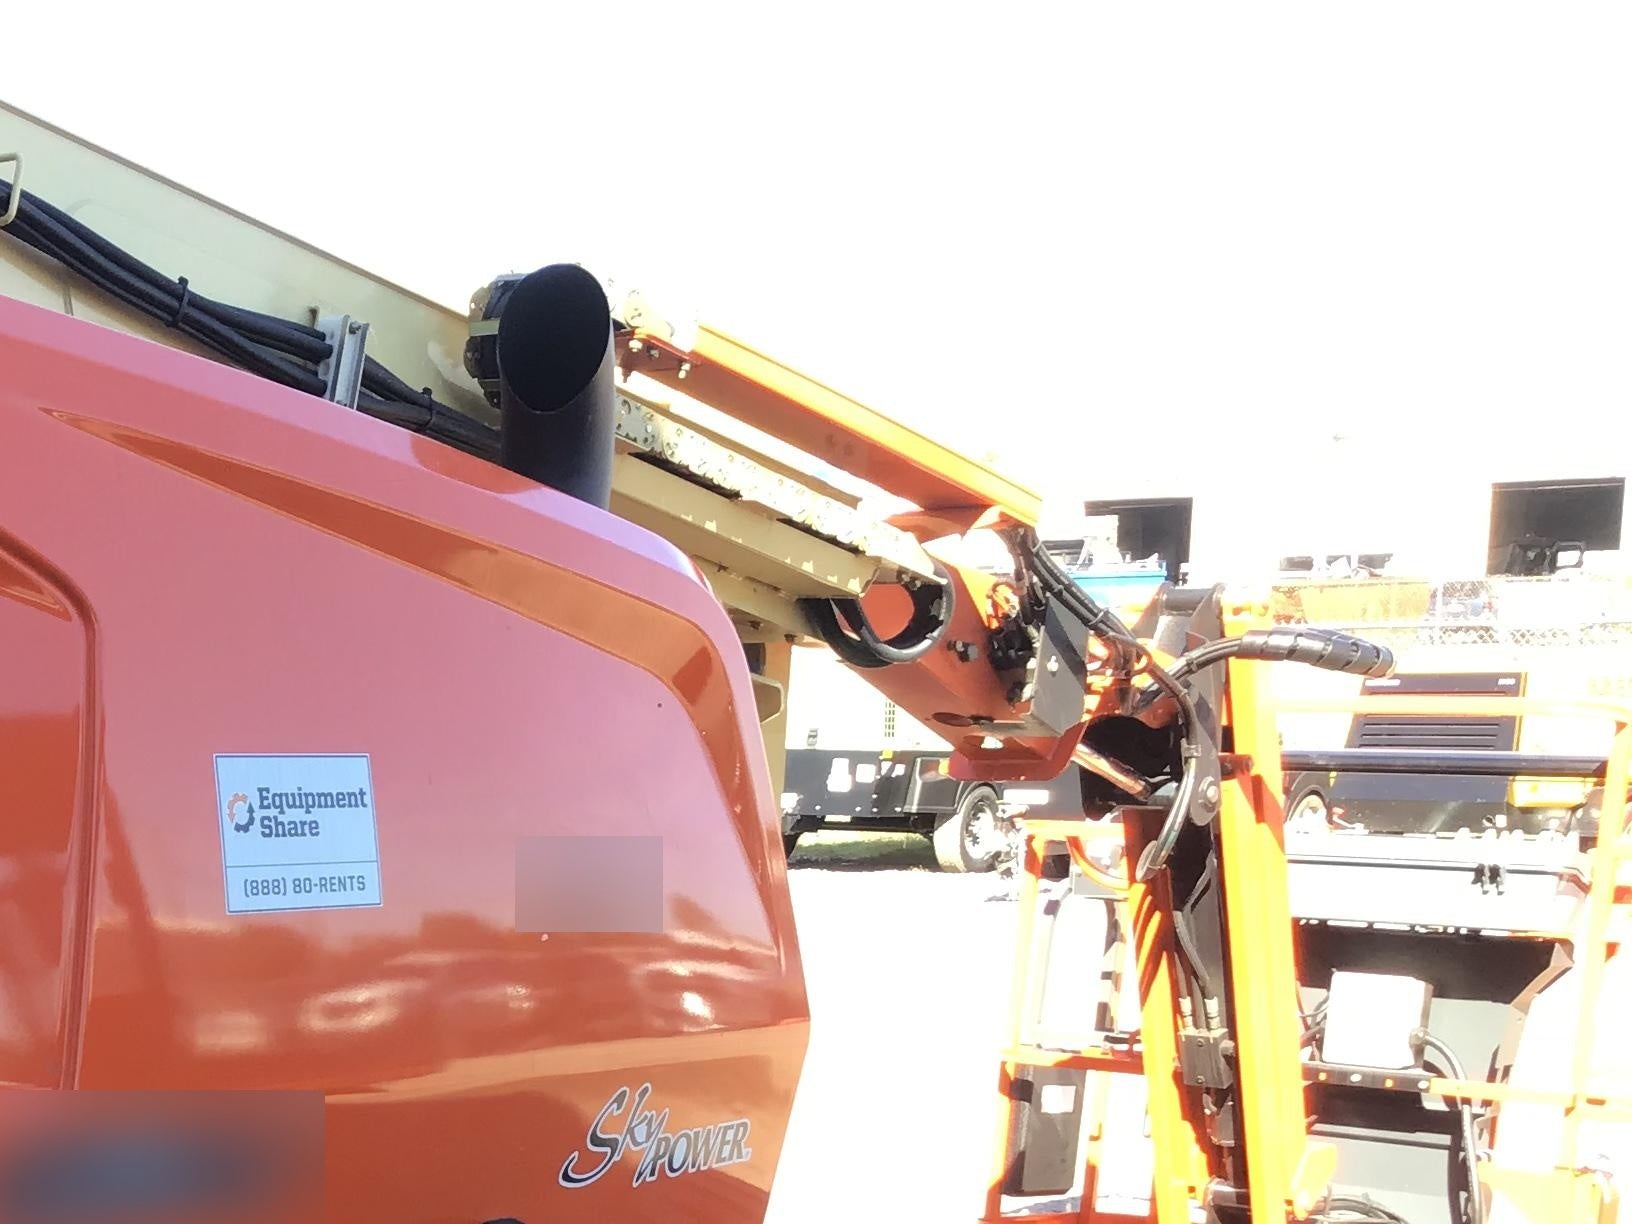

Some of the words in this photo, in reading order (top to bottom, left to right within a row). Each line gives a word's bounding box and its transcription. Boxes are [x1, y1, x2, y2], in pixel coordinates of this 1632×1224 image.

[257, 786, 368, 815] Equipment
[259, 815, 321, 838] Share
[243, 876, 287, 898] (888)
[292, 874, 366, 895] 80-RENTS
[560, 1084, 669, 1187] Sky
[647, 1120, 751, 1180] POWER
